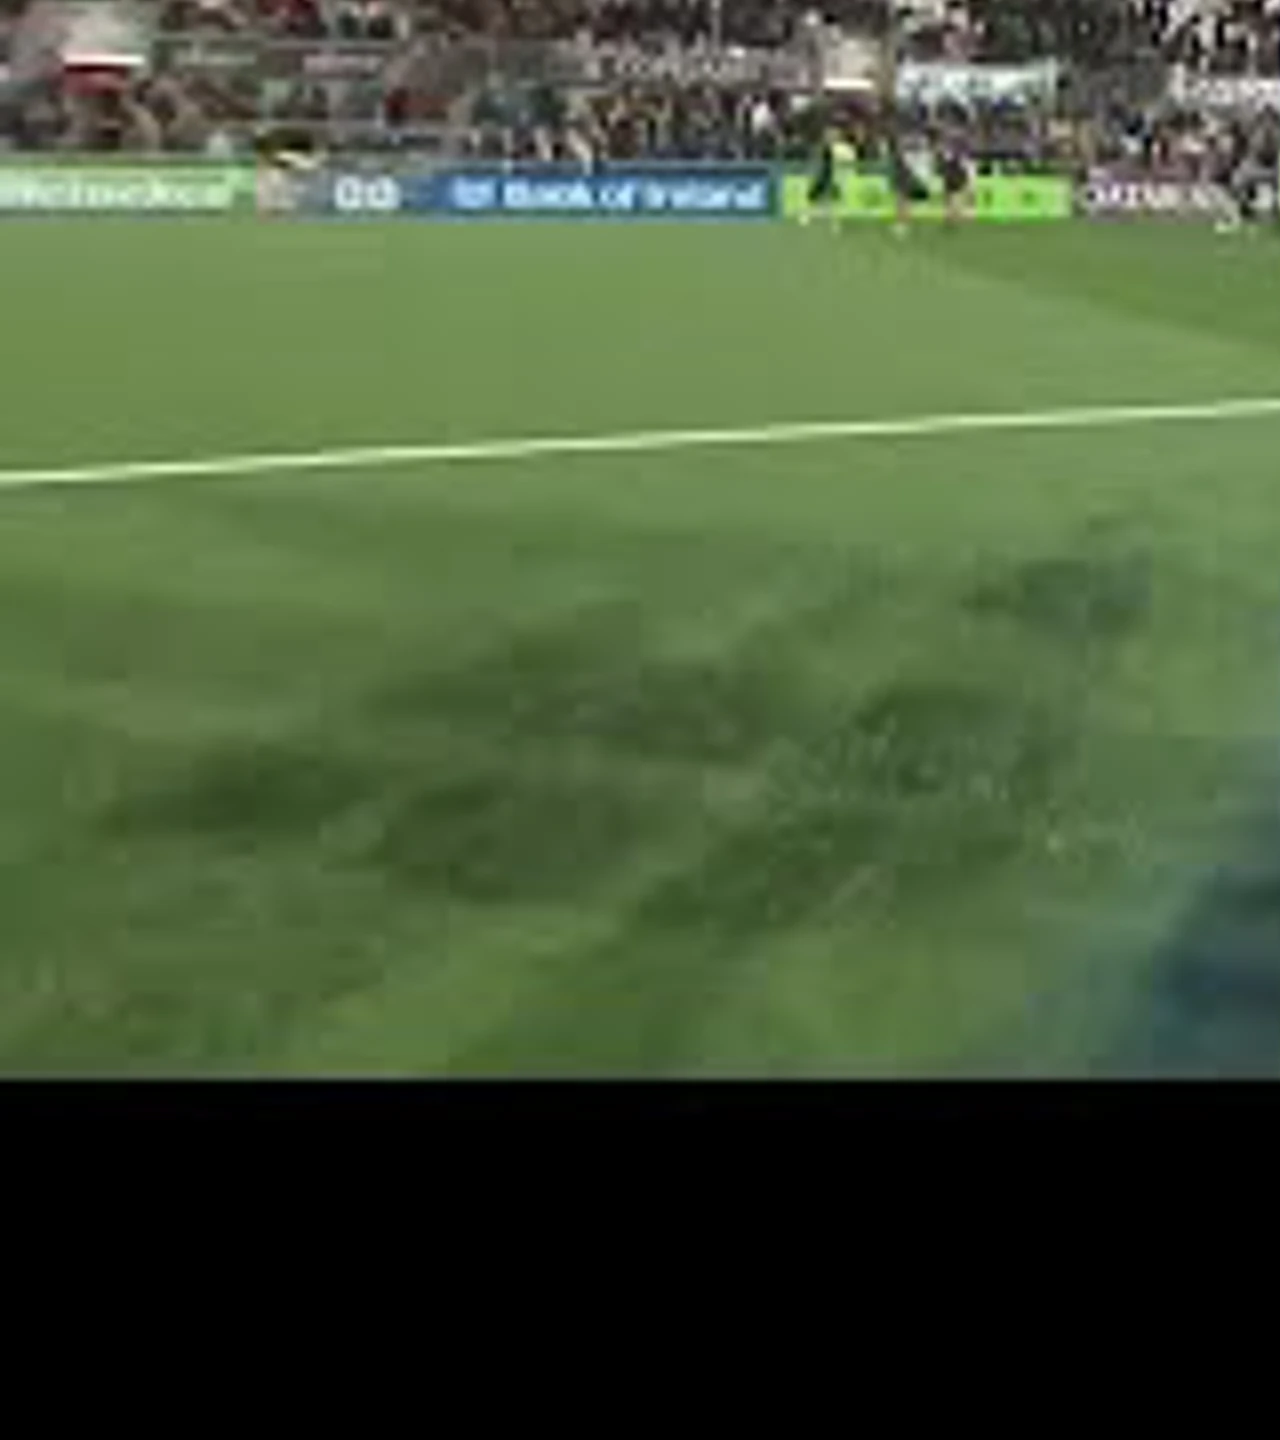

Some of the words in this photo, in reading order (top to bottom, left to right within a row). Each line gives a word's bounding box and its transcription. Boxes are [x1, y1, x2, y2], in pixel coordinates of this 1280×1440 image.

[503, 168, 594, 210] Bank
[600, 168, 635, 210] of
[642, 168, 769, 210] Ireland
